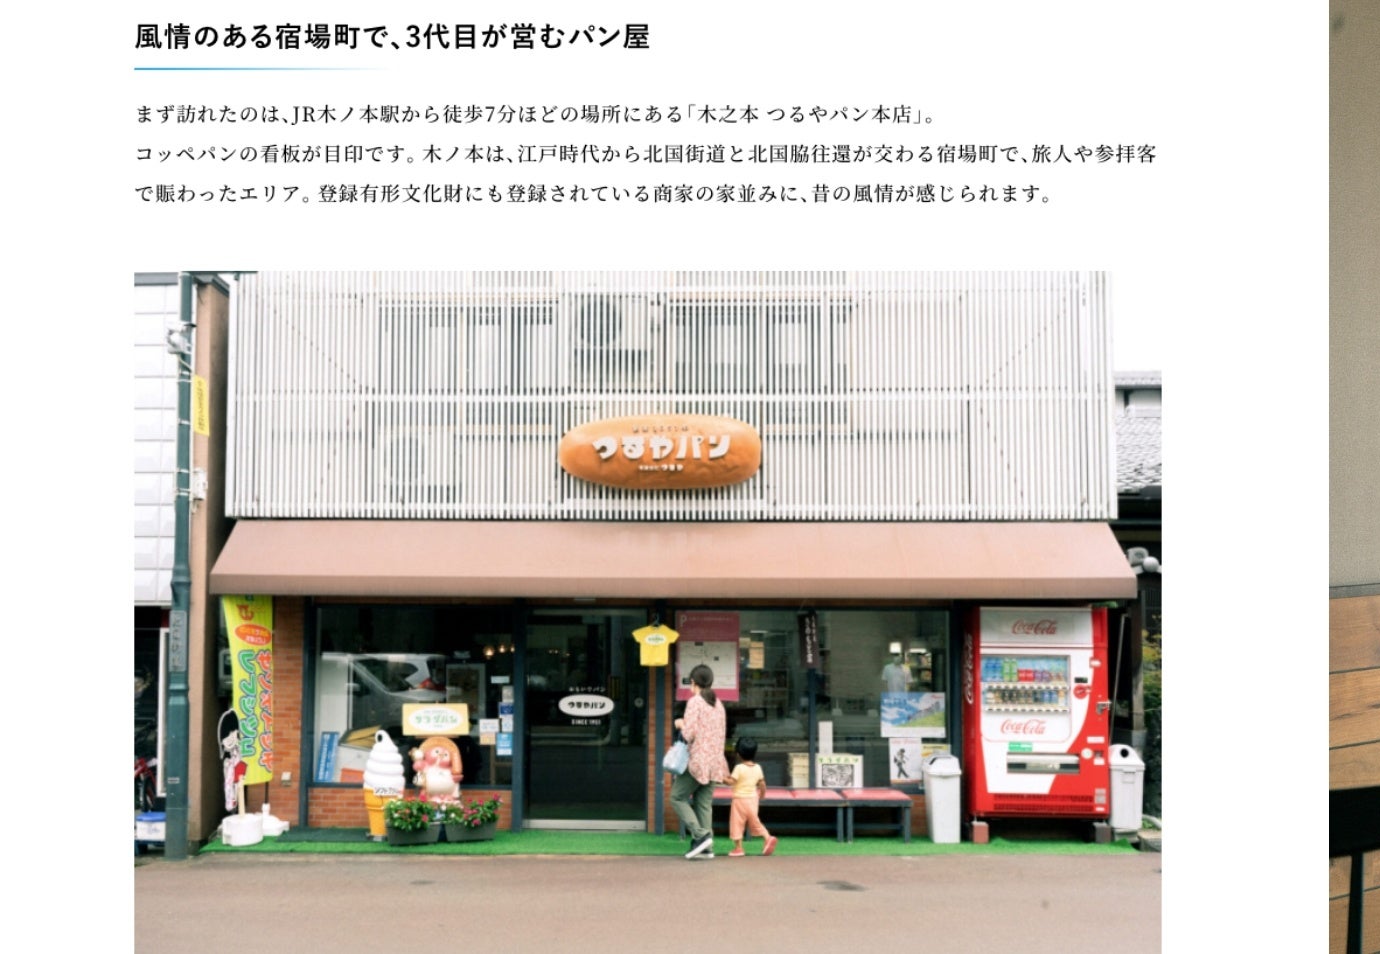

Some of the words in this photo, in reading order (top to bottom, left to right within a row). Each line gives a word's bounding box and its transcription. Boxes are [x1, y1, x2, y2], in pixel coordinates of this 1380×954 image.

[592, 434, 731, 460] つるやパン
[568, 701, 606, 709] つるやパン
